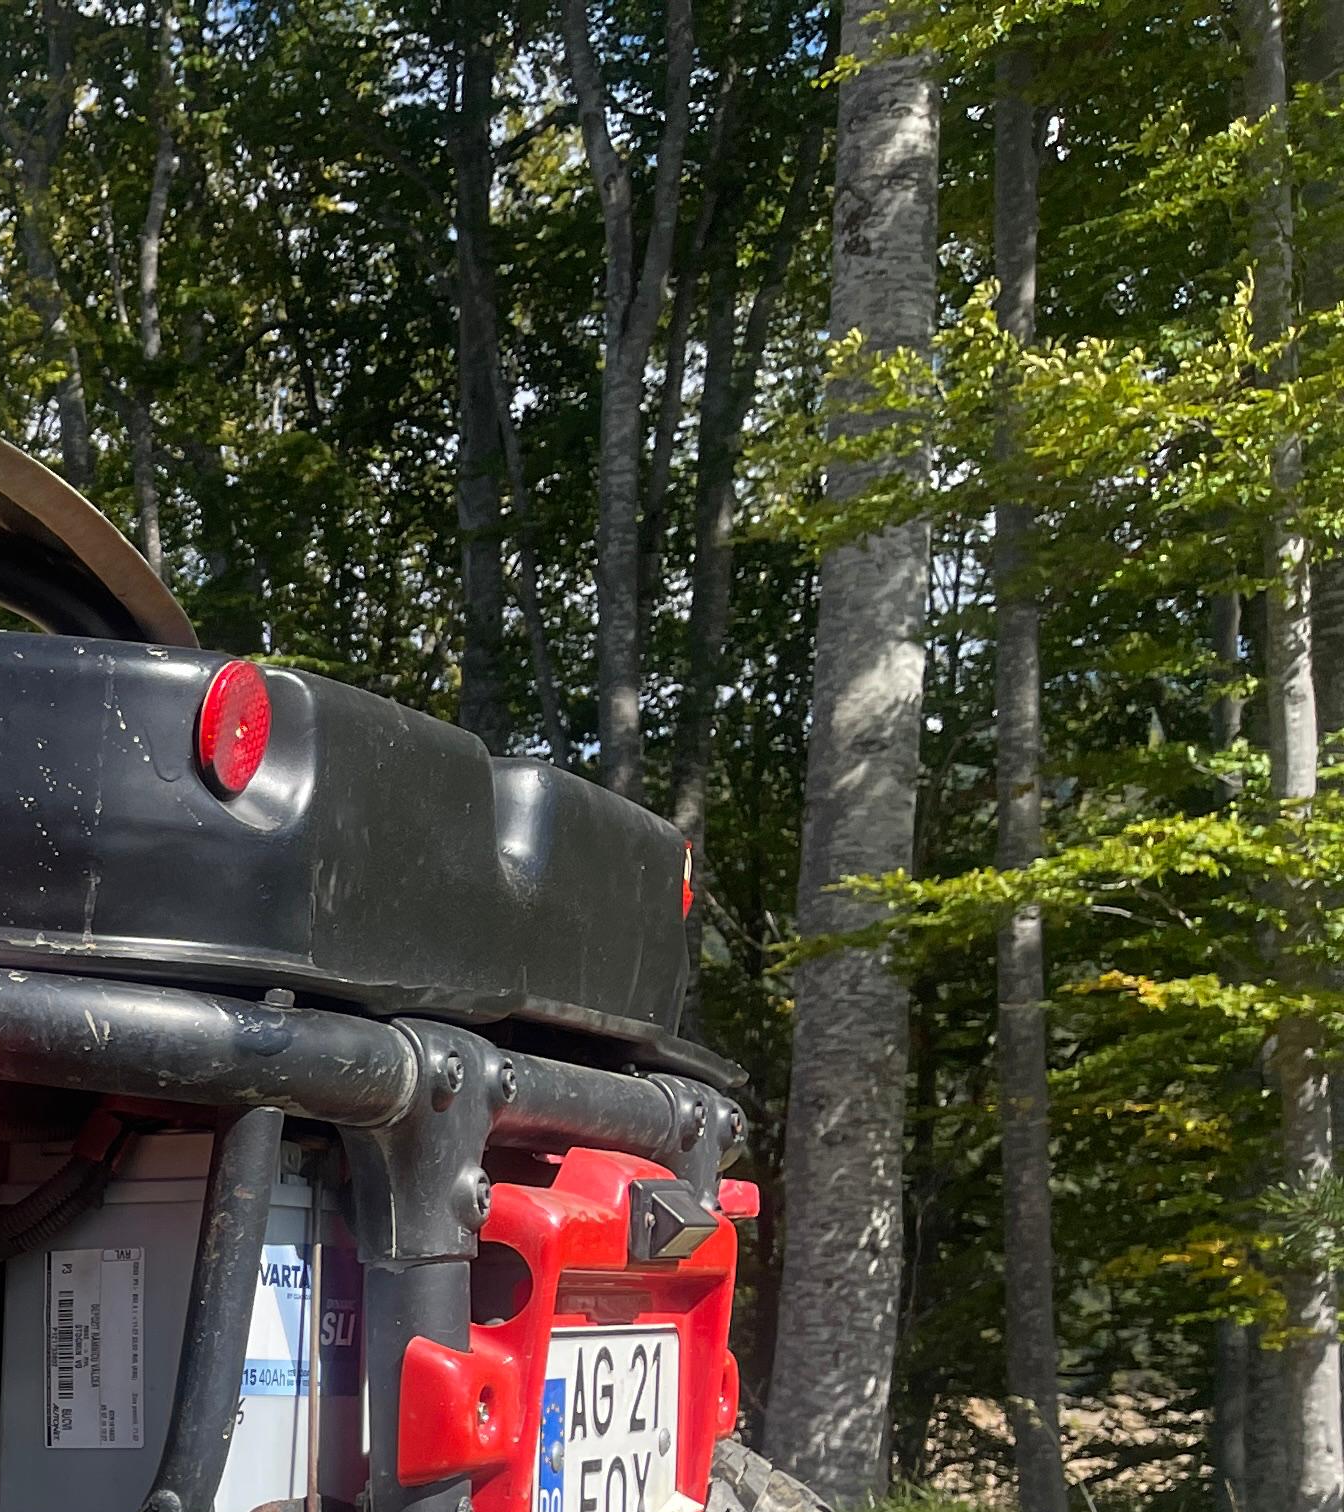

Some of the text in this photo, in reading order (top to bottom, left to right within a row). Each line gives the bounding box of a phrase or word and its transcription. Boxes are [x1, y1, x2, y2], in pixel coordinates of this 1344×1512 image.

[62, 1263, 73, 1275] P3
[261, 1263, 312, 1289] VARTA
[320, 1311, 356, 1346] SLI
[240, 1368, 257, 1386] 15
[259, 1368, 286, 1387] 40Ah
[570, 1342, 662, 1443] AG 21
